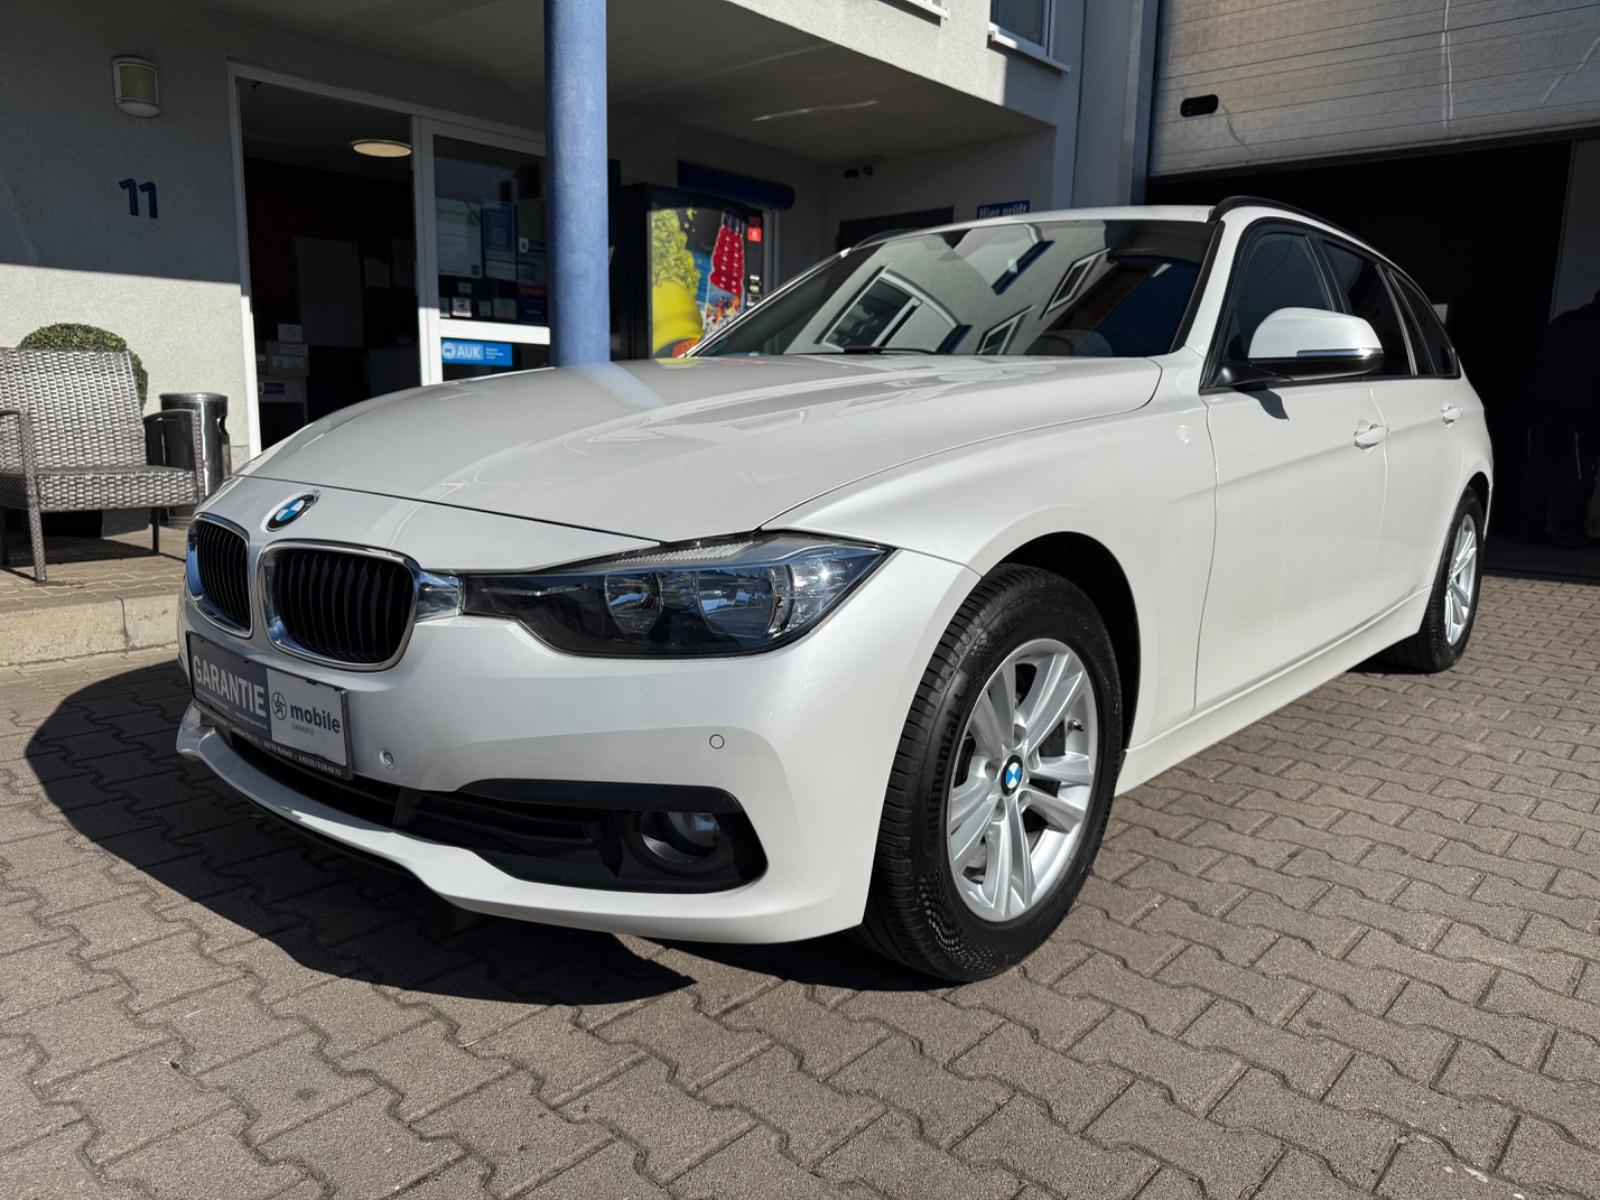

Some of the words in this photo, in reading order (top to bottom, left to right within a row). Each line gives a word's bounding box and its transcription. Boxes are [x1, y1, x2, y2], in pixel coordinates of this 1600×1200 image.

[118, 178, 158, 219] 11
[457, 344, 481, 360] AUK
[193, 655, 267, 718] GARANTIE
[289, 703, 341, 734] mobile
